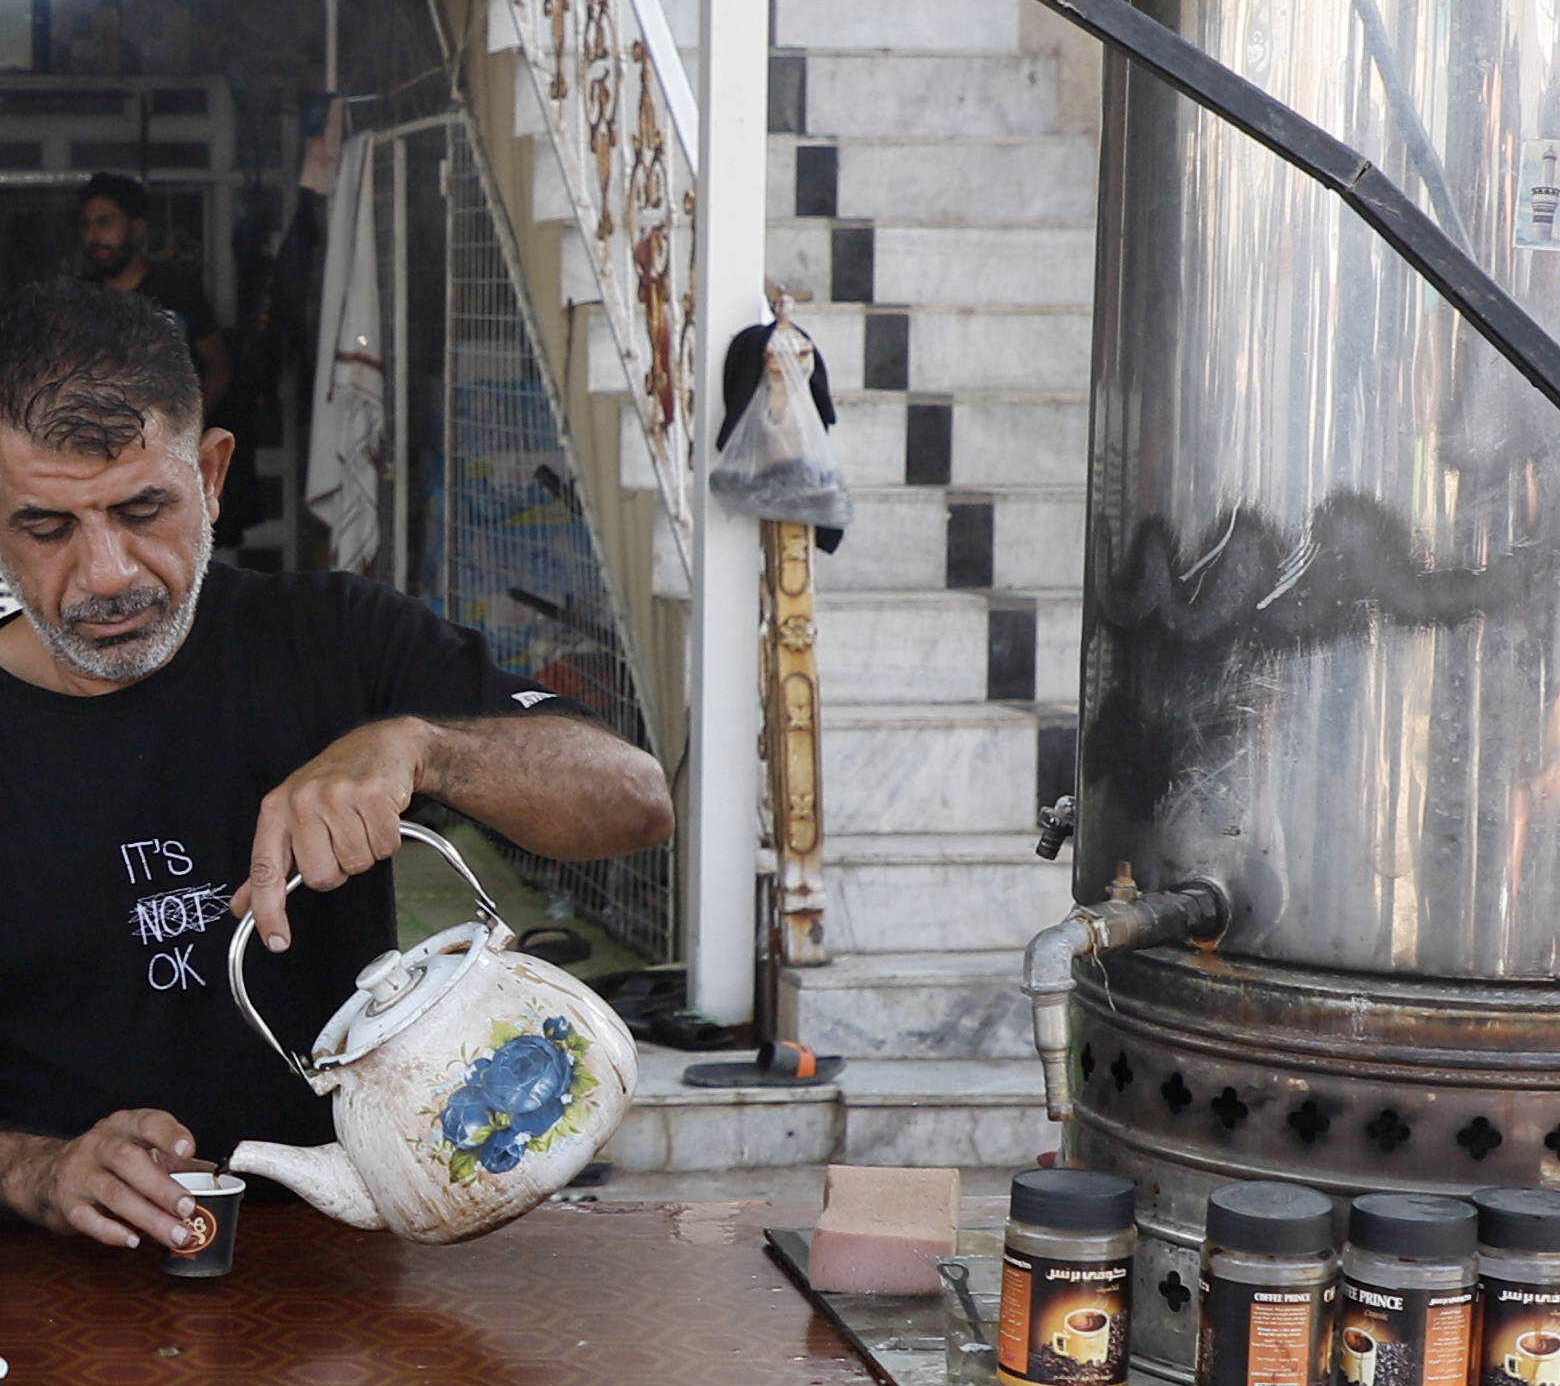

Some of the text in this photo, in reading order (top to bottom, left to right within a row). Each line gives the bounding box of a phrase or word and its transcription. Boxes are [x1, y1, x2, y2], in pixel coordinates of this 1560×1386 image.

[119, 839, 193, 884] IT'S
[147, 944, 207, 991] OK
[1045, 1267, 1127, 1283] كوفي برنس
[1254, 1292, 1283, 1303] COFFEE
[1284, 1292, 1312, 1303] PRINCE
[1359, 1289, 1404, 1311] PRINCE
[1498, 1289, 1533, 1305] برنس
